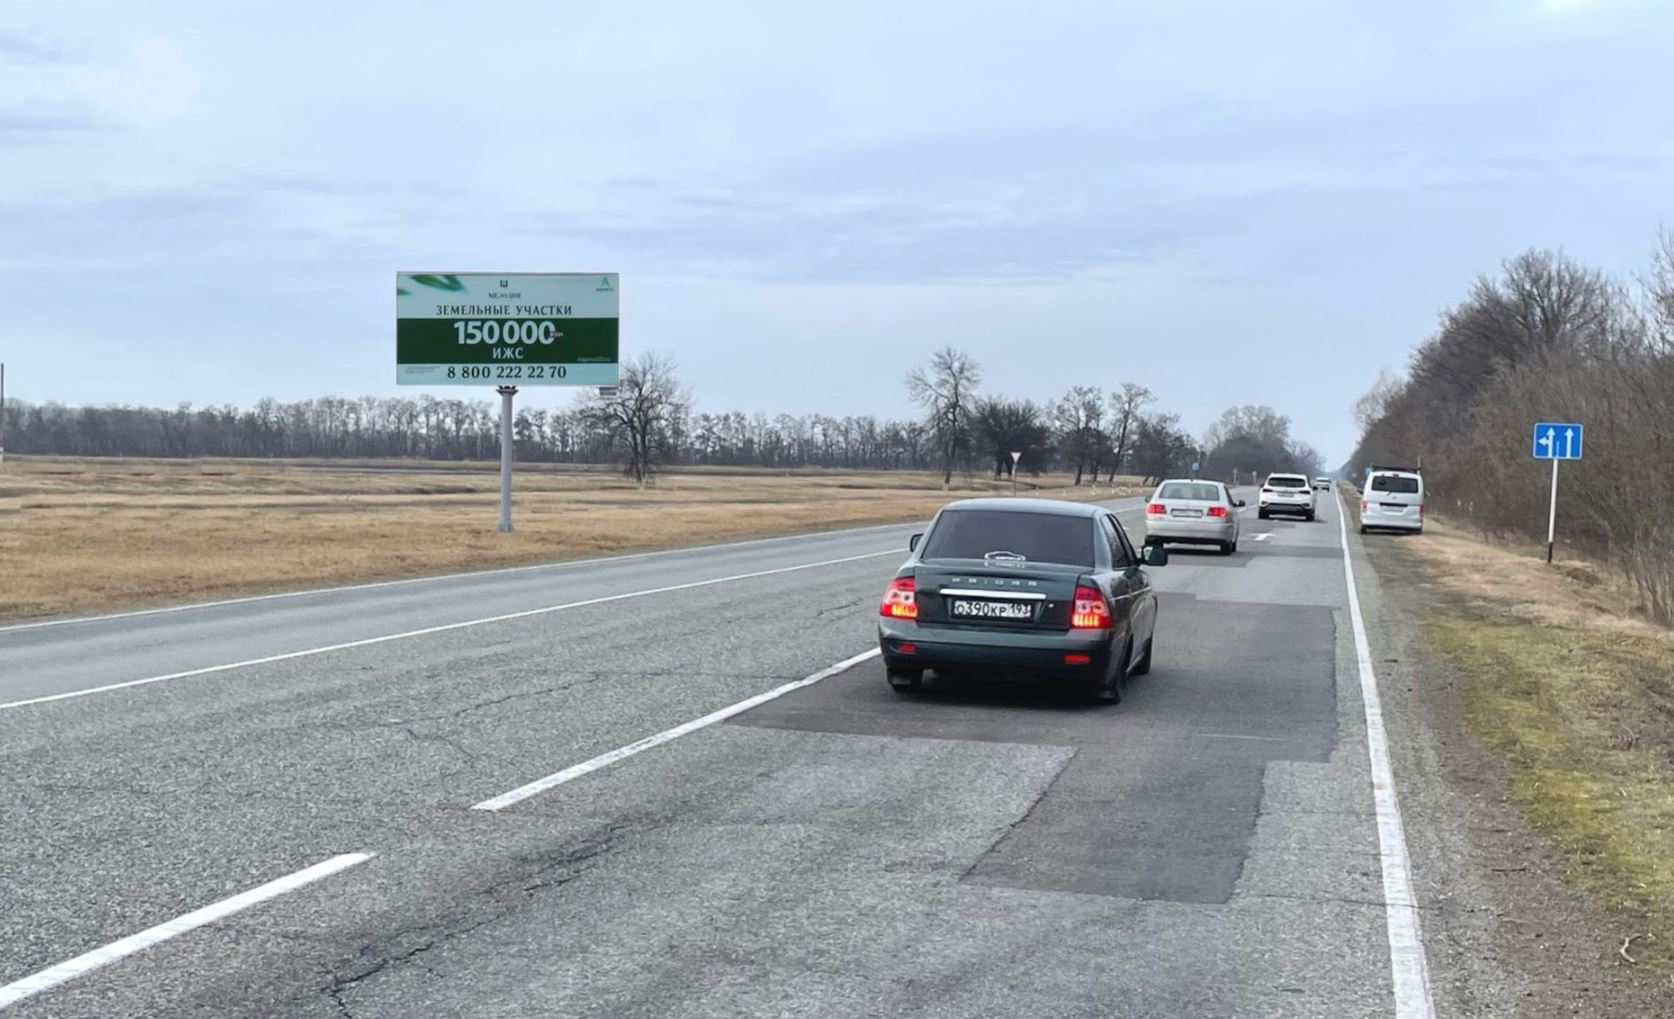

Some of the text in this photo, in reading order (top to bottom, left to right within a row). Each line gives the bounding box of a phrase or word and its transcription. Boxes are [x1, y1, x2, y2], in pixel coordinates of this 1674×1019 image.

[436, 304, 572, 316] ЗЕМЕЛЬНЫЕ УЧАСТКИ
[492, 347, 524, 360] ИЖС
[447, 366, 456, 379] 8
[461, 366, 491, 379] 800
[496, 366, 522, 379] 222
[527, 366, 544, 379] 22
[549, 366, 567, 379] 70
